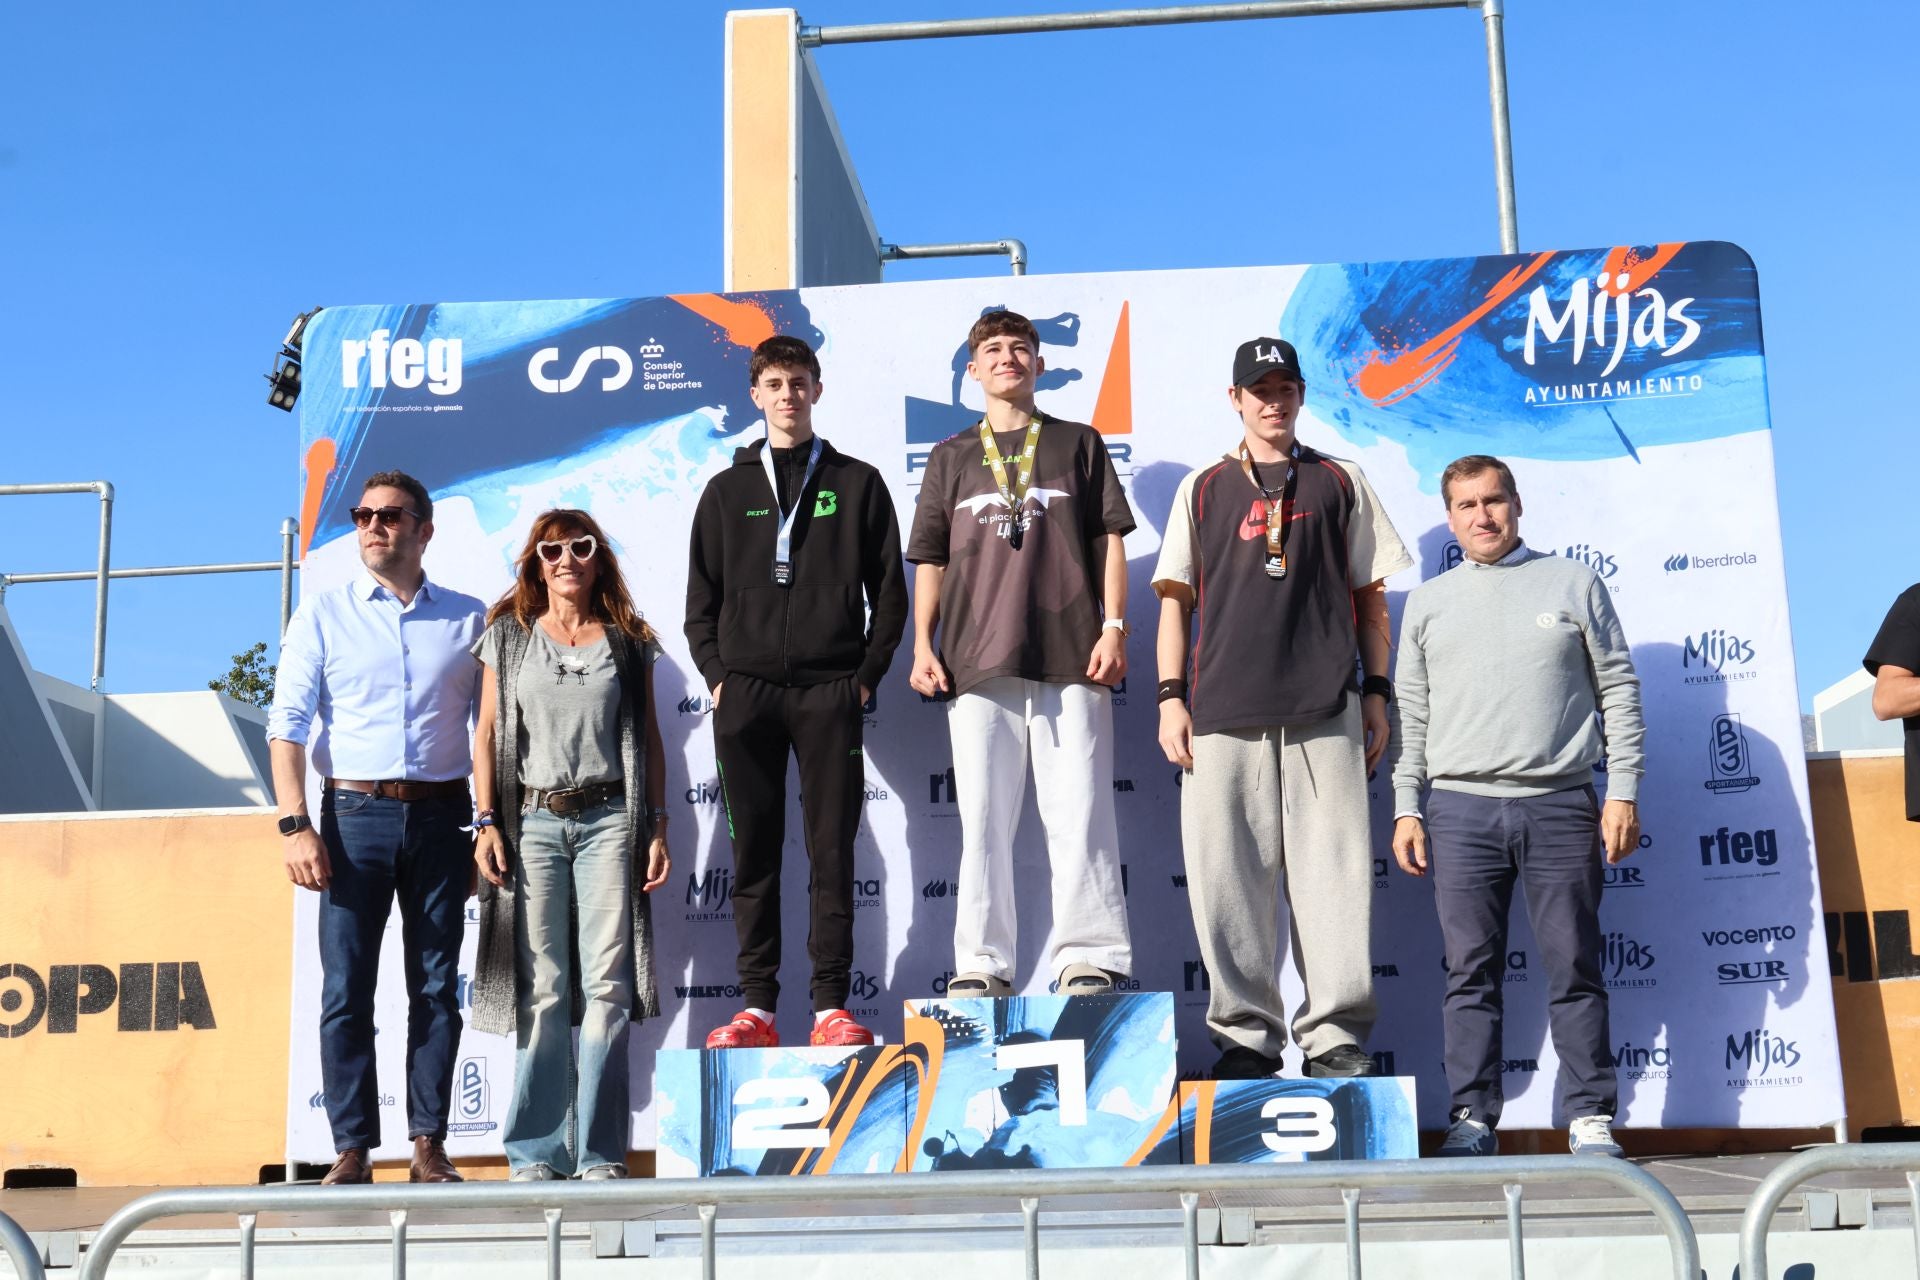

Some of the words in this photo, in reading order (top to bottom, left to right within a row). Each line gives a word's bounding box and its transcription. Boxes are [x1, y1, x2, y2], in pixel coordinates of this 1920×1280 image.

[1523, 272, 1701, 377] Mijas
[342, 328, 463, 396] rfeg
[1255, 344, 1284, 363] LA
[643, 361, 682, 374] Consejo
[643, 371, 686, 382] Superior
[643, 382, 656, 390] de
[658, 380, 702, 391] Deportes
[1525, 375, 1703, 403] AYUNTAMIENTO
[392, 404, 421, 414] española
[423, 404, 432, 412] de
[433, 403, 463, 414] gimnasia
[979, 515, 988, 525] el
[1691, 551, 1757, 569] Iberdrola
[1683, 629, 1756, 673] Mijas
[1684, 670, 1758, 684] AYUNTAMIENTO
[1706, 777, 1759, 788] SPORTAINMENT
[1699, 827, 1778, 866] rfeg
[1602, 867, 1645, 884] UR
[1718, 960, 1789, 981] SUR
[1726, 1029, 1801, 1076] Mijas
[1626, 1070, 1672, 1082] seguros
[1726, 1077, 1803, 1088] AYUNTAMIENTO
[732, 1077, 830, 1151] 2
[1260, 1097, 1337, 1153] 3
